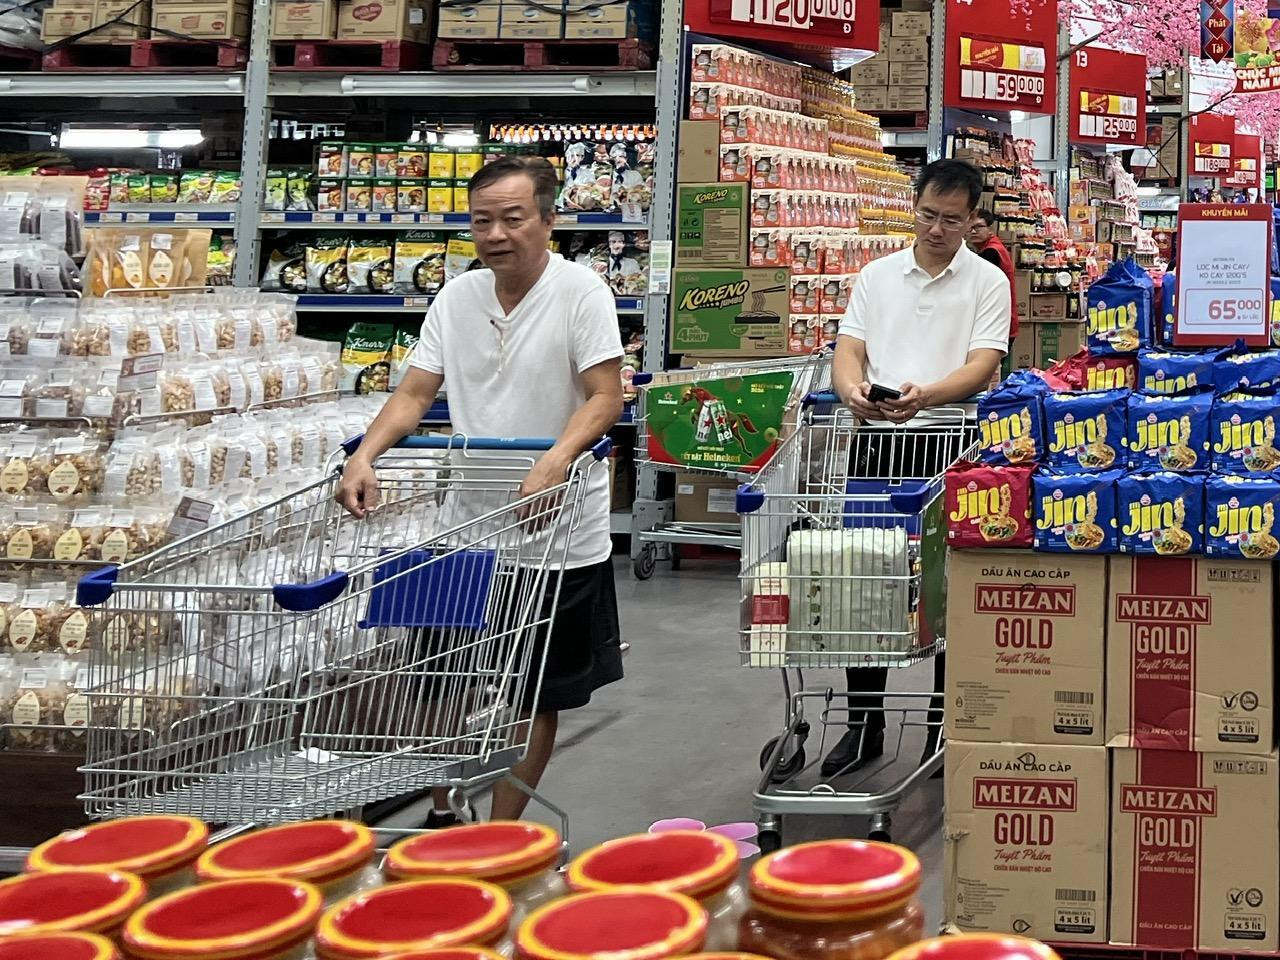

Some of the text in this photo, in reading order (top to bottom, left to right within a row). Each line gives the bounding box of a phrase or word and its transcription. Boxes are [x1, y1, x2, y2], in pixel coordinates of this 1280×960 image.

[1208, 18, 1226, 28] Phát
[1075, 50, 1088, 67] 13
[1212, 43, 1224, 54] Tài
[1237, 67, 1266, 80] CHÚC
[694, 189, 728, 204] KORENO
[1201, 207, 1248, 217] KHUYẾN MÃI
[405, 230, 435, 239] Knorr
[679, 280, 750, 311] KORENO
[1087, 304, 1129, 335] jin
[352, 337, 385, 348] Knorr
[979, 413, 1022, 451] jin
[1050, 417, 1097, 452] jin
[1130, 419, 1179, 452] jin
[1213, 420, 1264, 454] jin
[950, 485, 1001, 522] jin
[1036, 494, 1086, 530] jin
[1122, 501, 1173, 536] jin
[1209, 505, 1262, 538] jin
[980, 589, 1071, 611] MEIZAN
[1121, 600, 1207, 619] MEIZAN
[995, 616, 1053, 649] GOLD
[1136, 626, 1190, 654] GOLD
[978, 784, 1072, 806] MEIZAN
[1125, 790, 1212, 811] MEIZAN
[994, 813, 1054, 846] GOLD
[1141, 817, 1194, 847] GOLD
